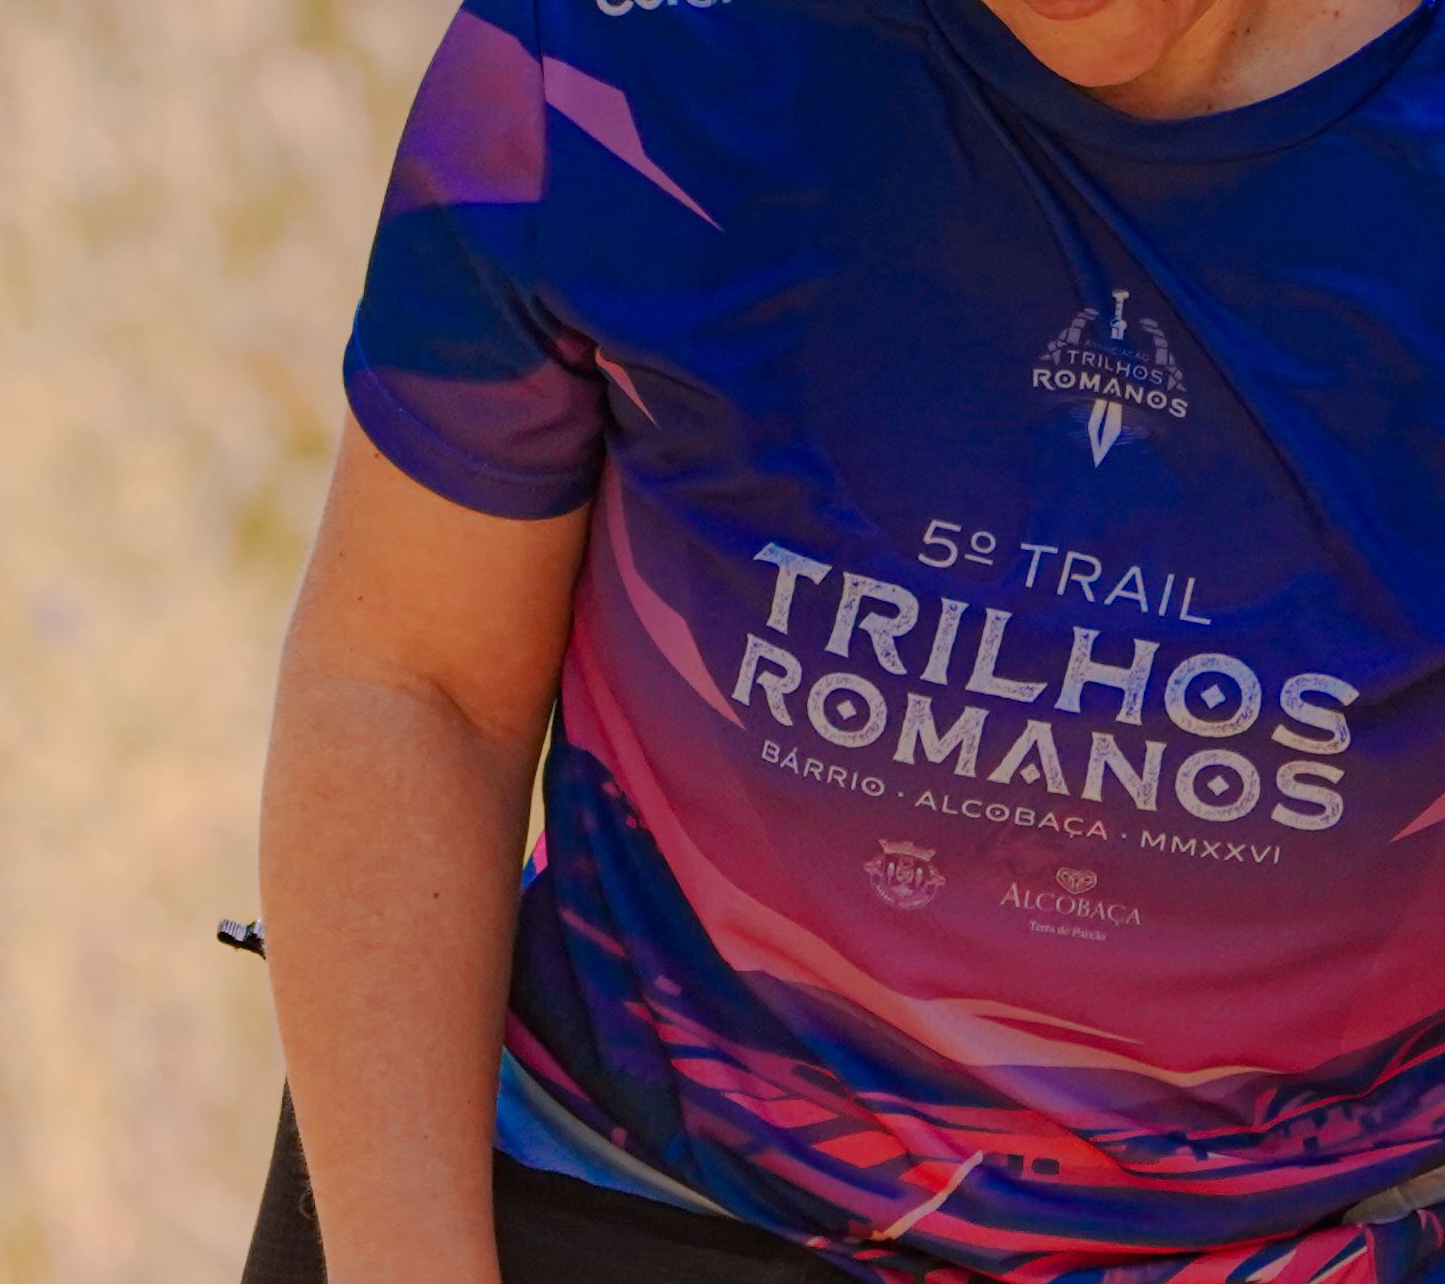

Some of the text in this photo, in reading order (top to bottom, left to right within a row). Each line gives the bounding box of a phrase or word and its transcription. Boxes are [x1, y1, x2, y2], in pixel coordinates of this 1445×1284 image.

[1033, 368, 1189, 418] ROMANOS
[1066, 349, 1164, 385] TRILHOS
[918, 518, 1212, 626] 5º TRAIL
[753, 541, 1360, 756] TRILHOS
[731, 632, 1345, 831] ROMANOS
[761, 738, 1281, 865] BÁRRIO ALCOBAÇA MMXXVI
